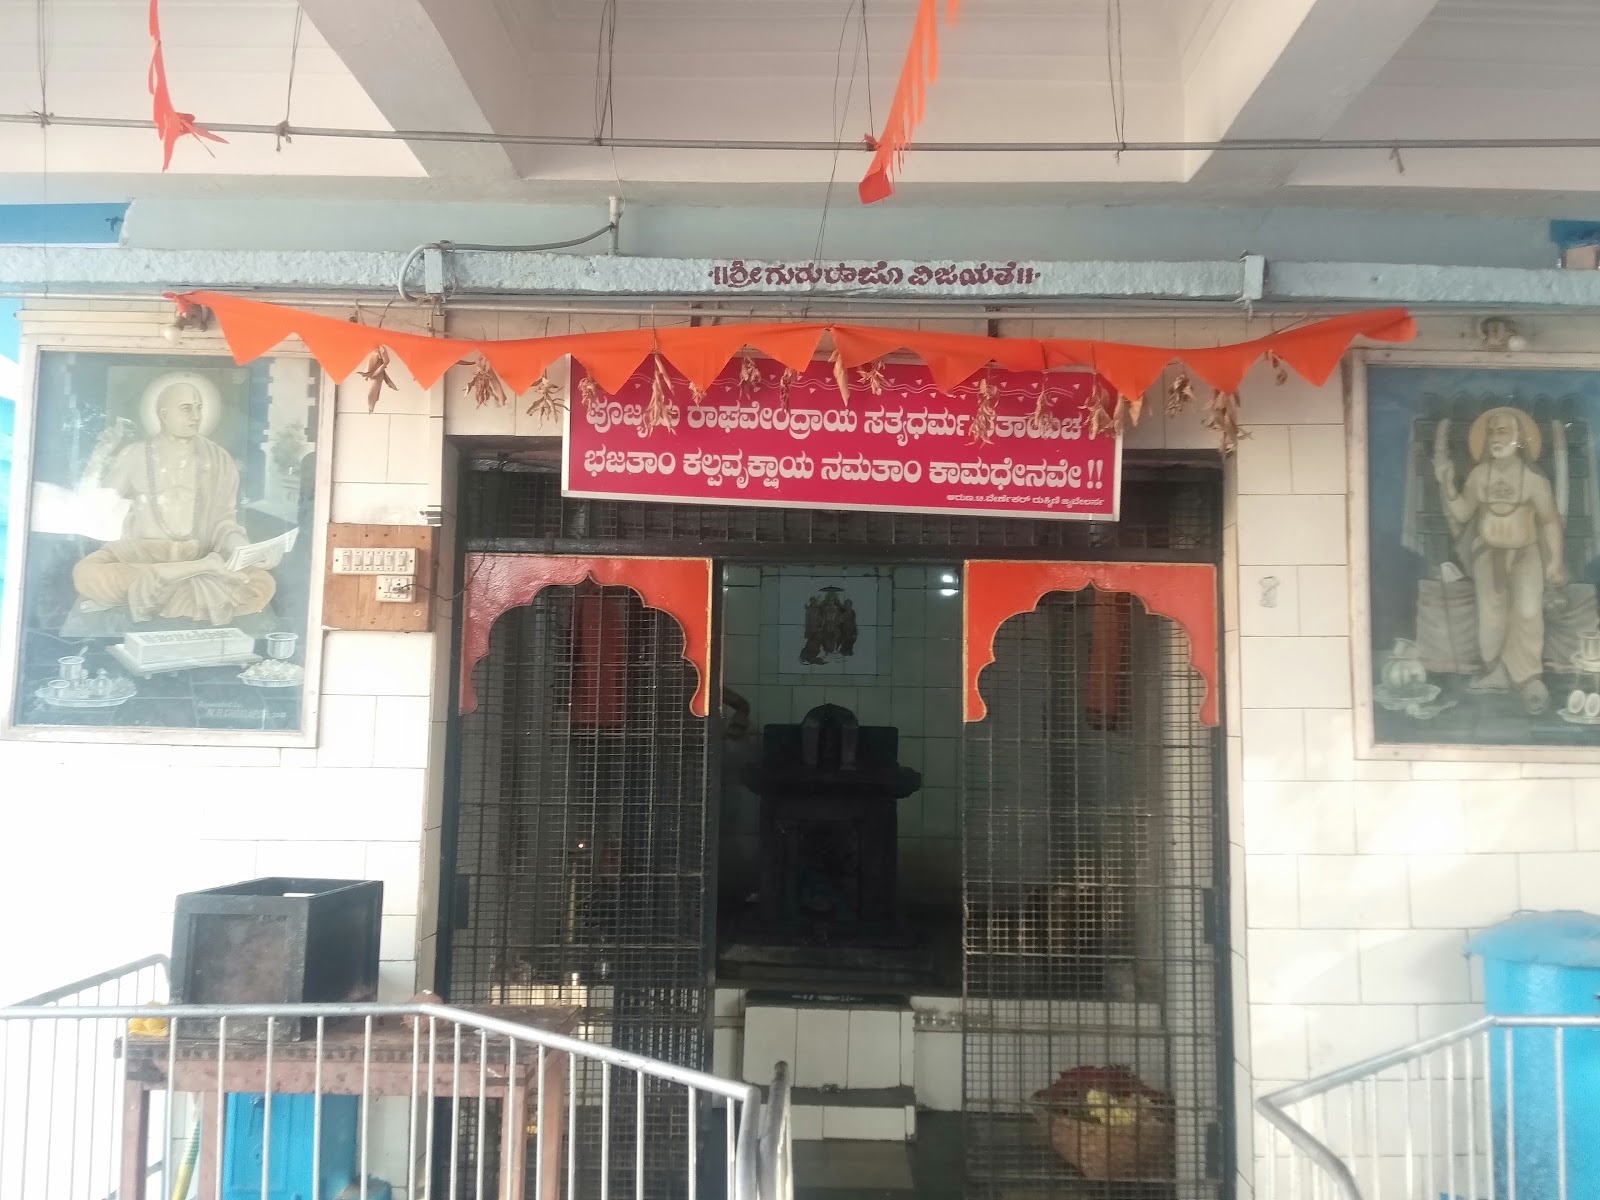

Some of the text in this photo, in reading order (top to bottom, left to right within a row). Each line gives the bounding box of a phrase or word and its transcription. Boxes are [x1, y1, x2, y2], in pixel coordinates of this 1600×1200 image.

[687, 400, 858, 440] ರಾಘವೇಂದ್ರಾಯ
[584, 444, 676, 477] ಭಜತಾಂ
[683, 447, 815, 489] ಕಲ್ಪವೃಕ್ಷಾಯ
[821, 450, 922, 482] ನಮತಾಂ
[929, 456, 1082, 491] ಕಾಮಧೇನವೇ
